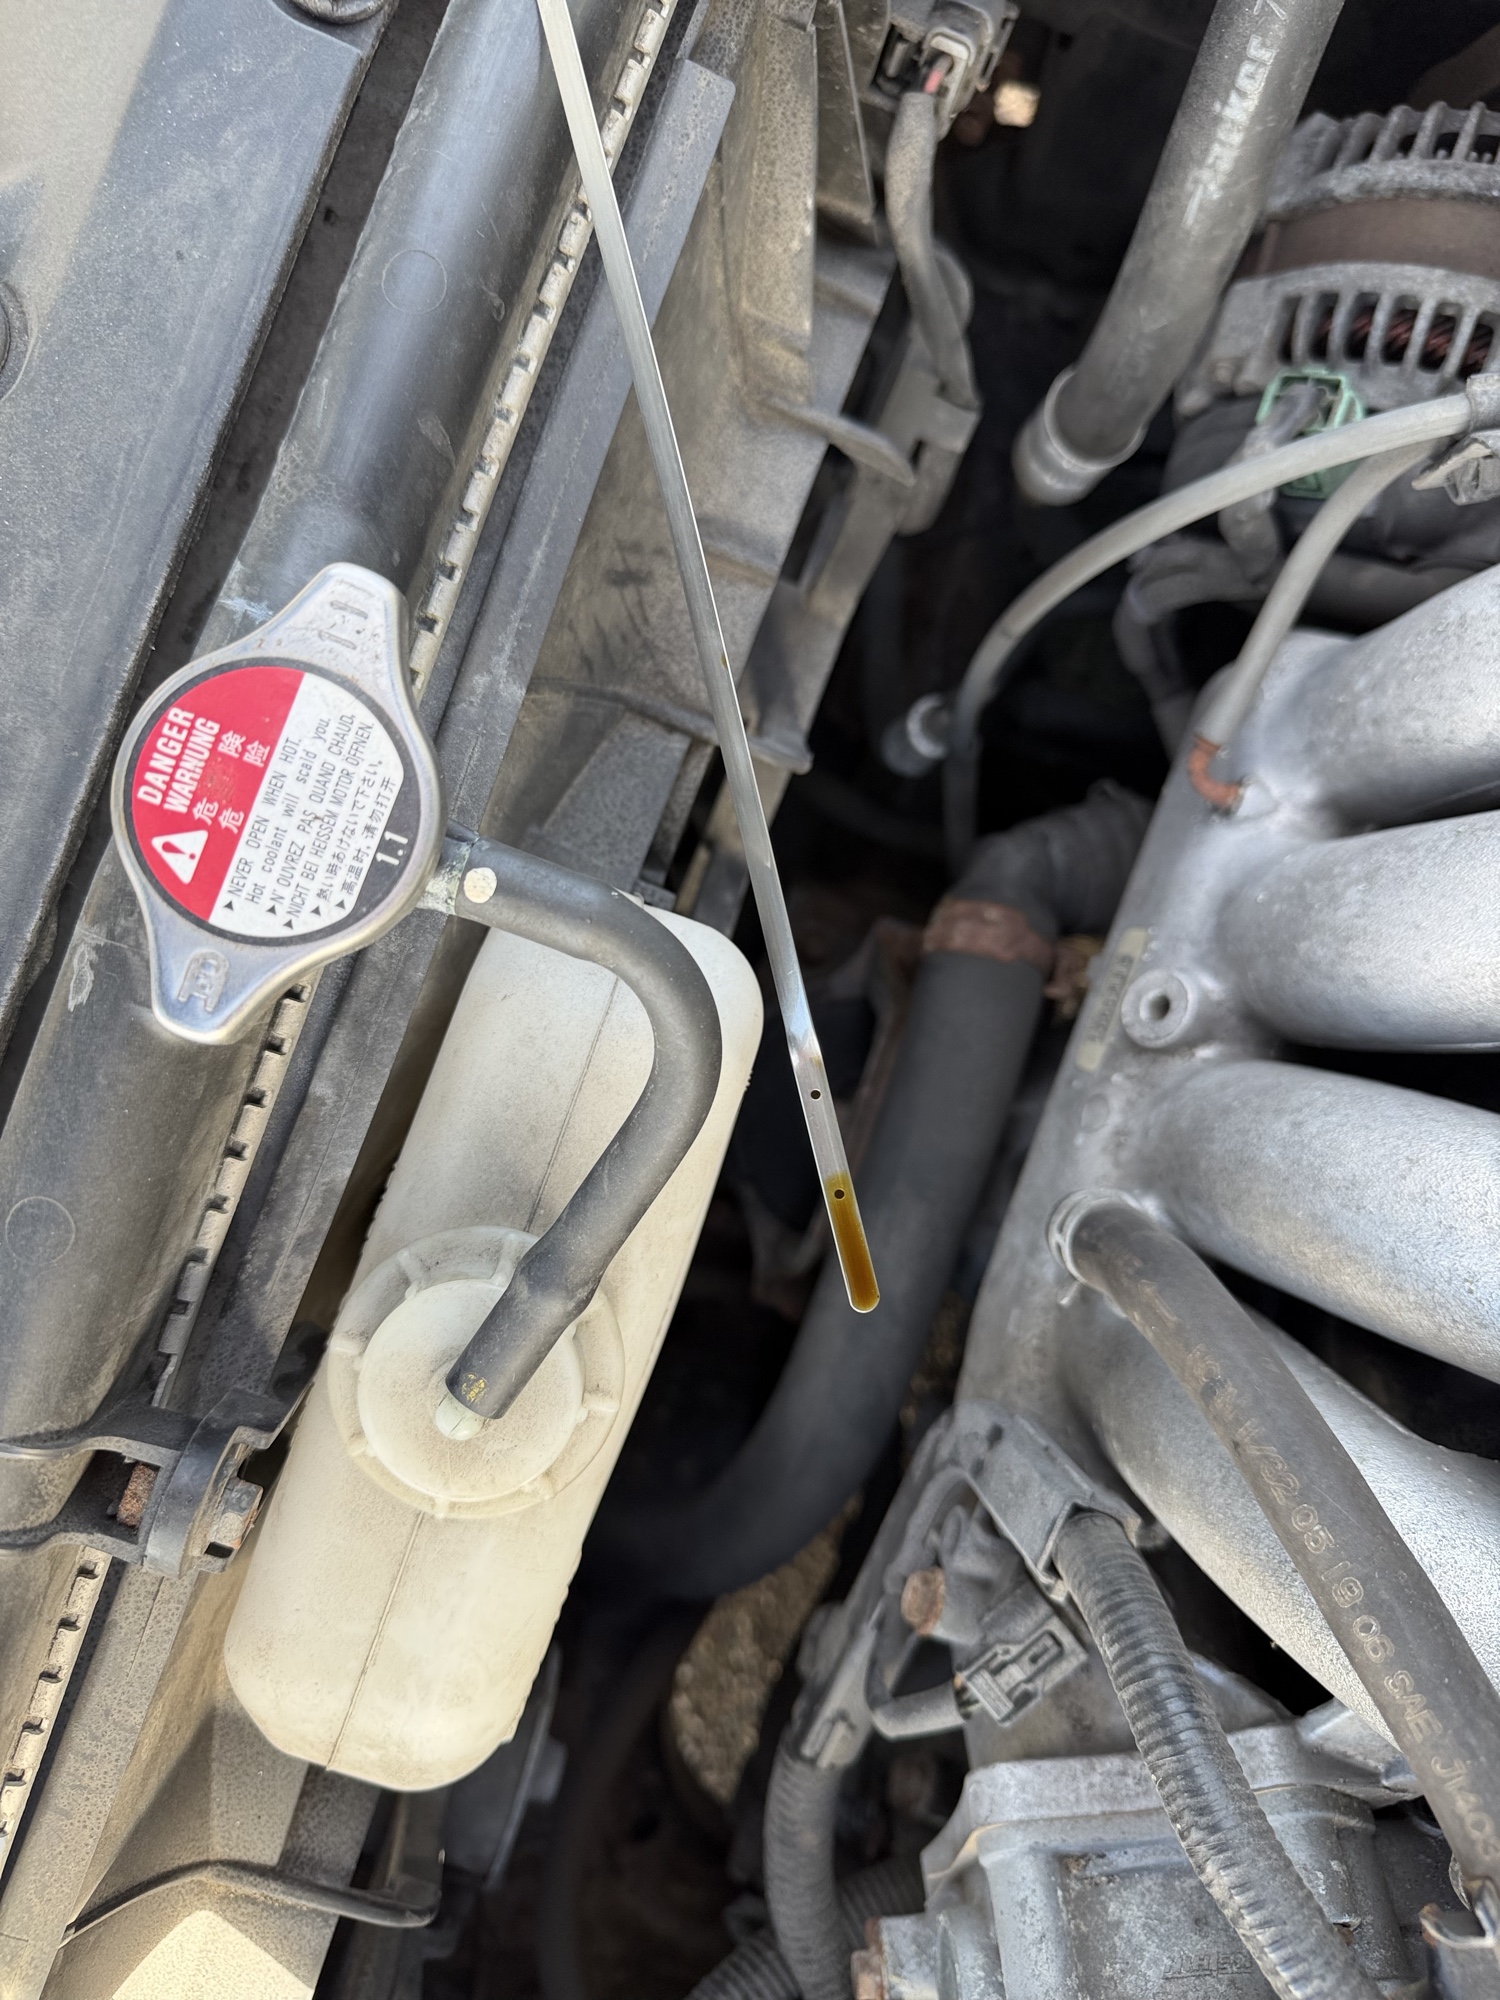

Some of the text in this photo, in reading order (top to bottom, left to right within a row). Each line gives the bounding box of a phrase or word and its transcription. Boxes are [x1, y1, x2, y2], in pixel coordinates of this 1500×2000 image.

[137, 707, 194, 805] DANGER
[163, 717, 220, 813] WARNUNG
[328, 768, 355, 806] MOTOR
[226, 736, 301, 897] NEVER OPEN WHEN HOT.
[244, 718, 331, 904] Hot coolant will scald you.
[276, 840, 305, 887] OUVREZ
[296, 809, 318, 834] PAS
[308, 761, 335, 803] QUAND
[309, 808, 339, 858] HEISSEM
[375, 830, 408, 865] 1.1
[285, 882, 309, 918] NICHT
[300, 860, 319, 881] BEI
[1291, 1504, 1335, 1553] 05
[1352, 1614, 1395, 1663] 06
[1384, 1670, 1443, 1743] SAE
